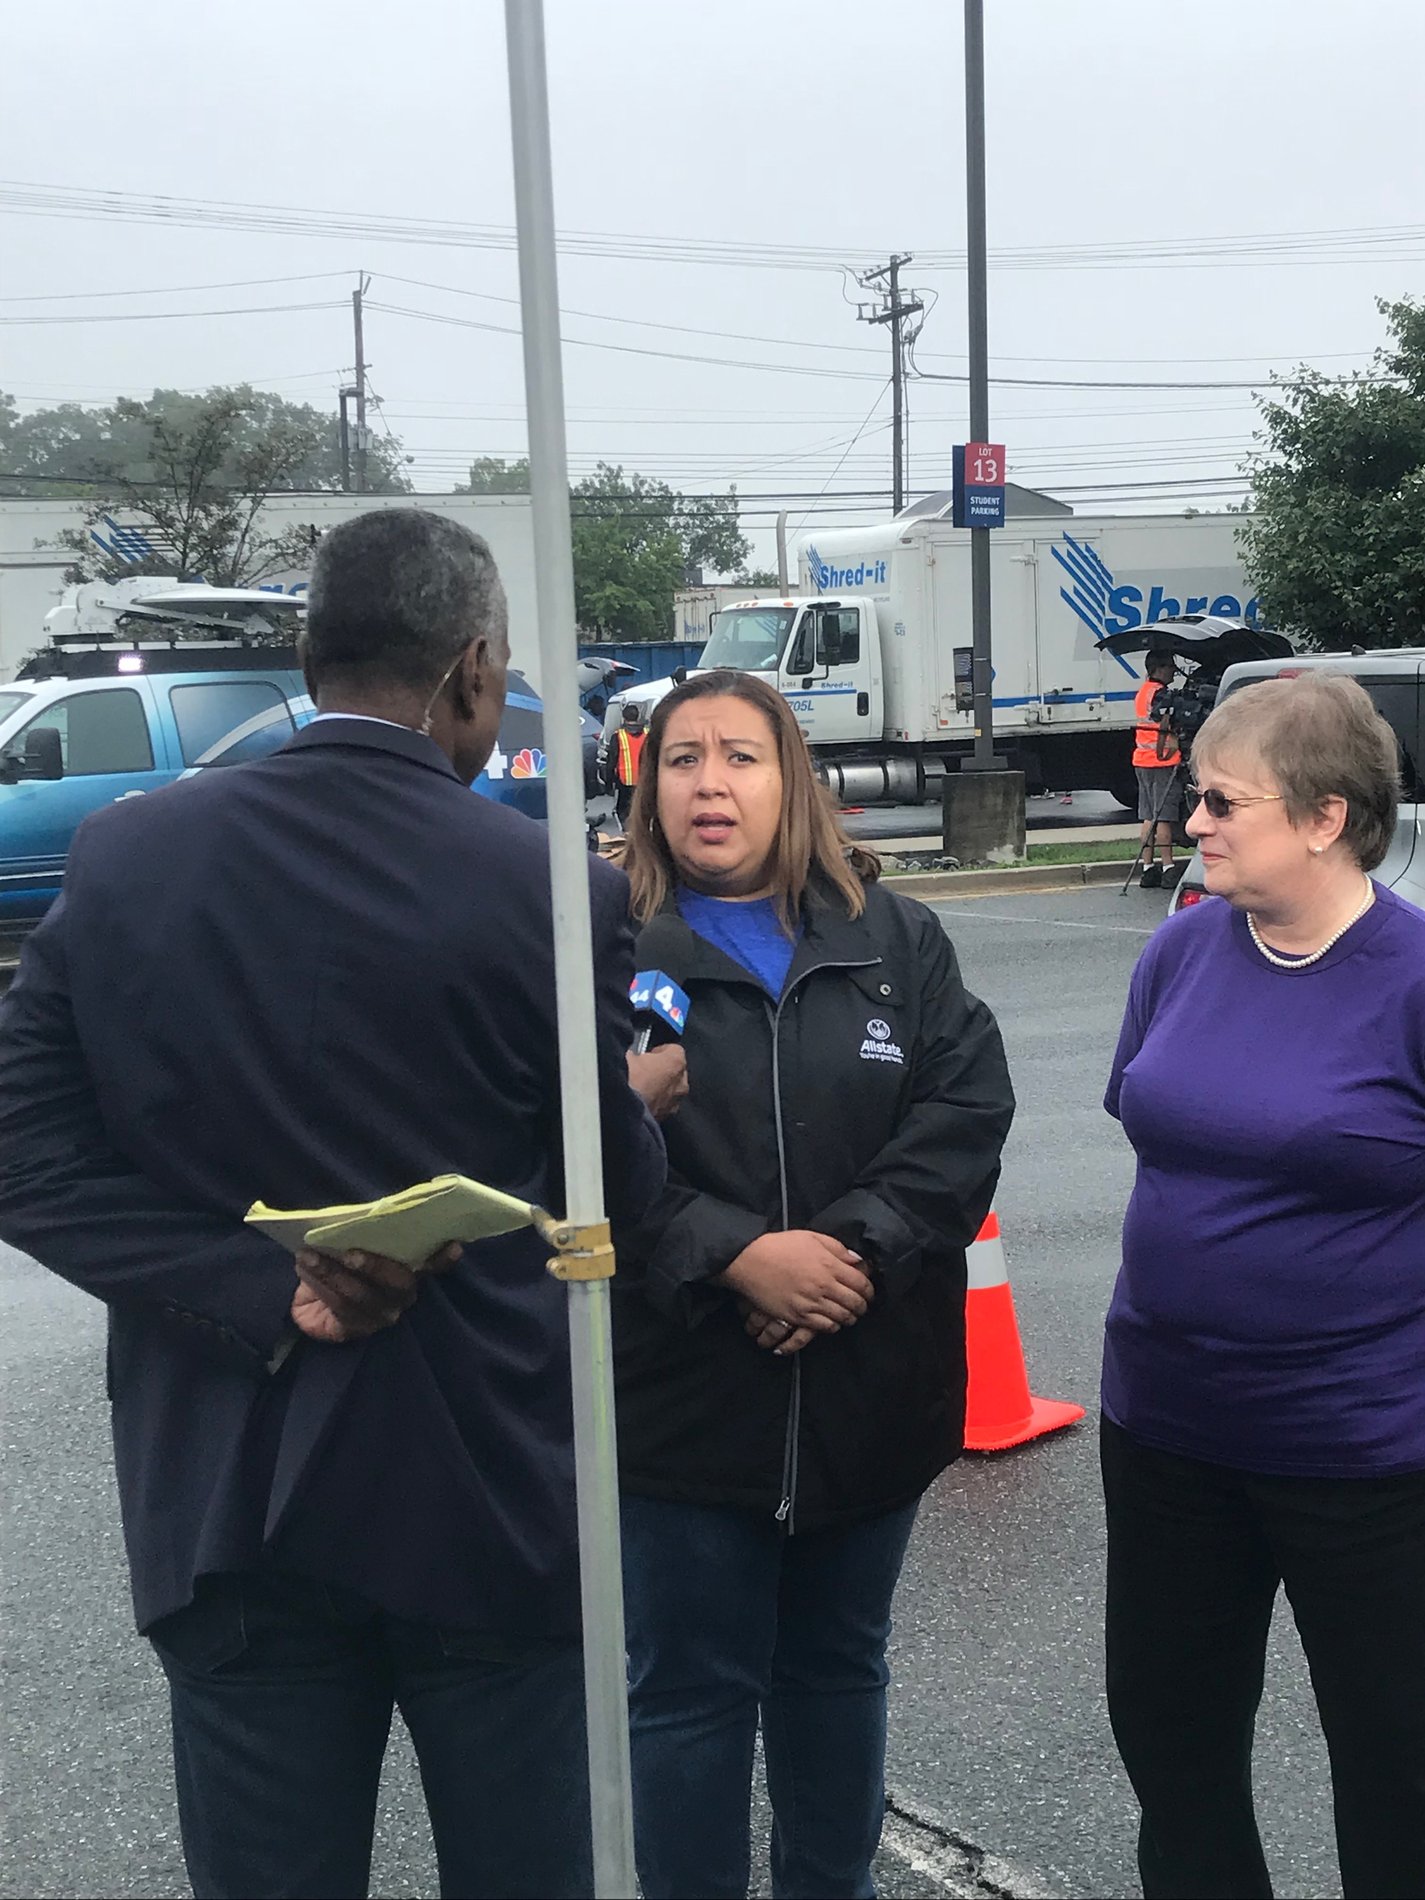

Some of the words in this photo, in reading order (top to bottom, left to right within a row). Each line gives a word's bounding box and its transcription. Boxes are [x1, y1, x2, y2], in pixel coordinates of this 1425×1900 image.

[978, 447, 993, 457] LOT
[973, 458, 998, 483] 13
[970, 496, 1001, 505] STUDENT
[970, 506, 1000, 516] PARKING
[820, 560, 887, 589] Shred-it
[654, 985, 675, 1013] 4
